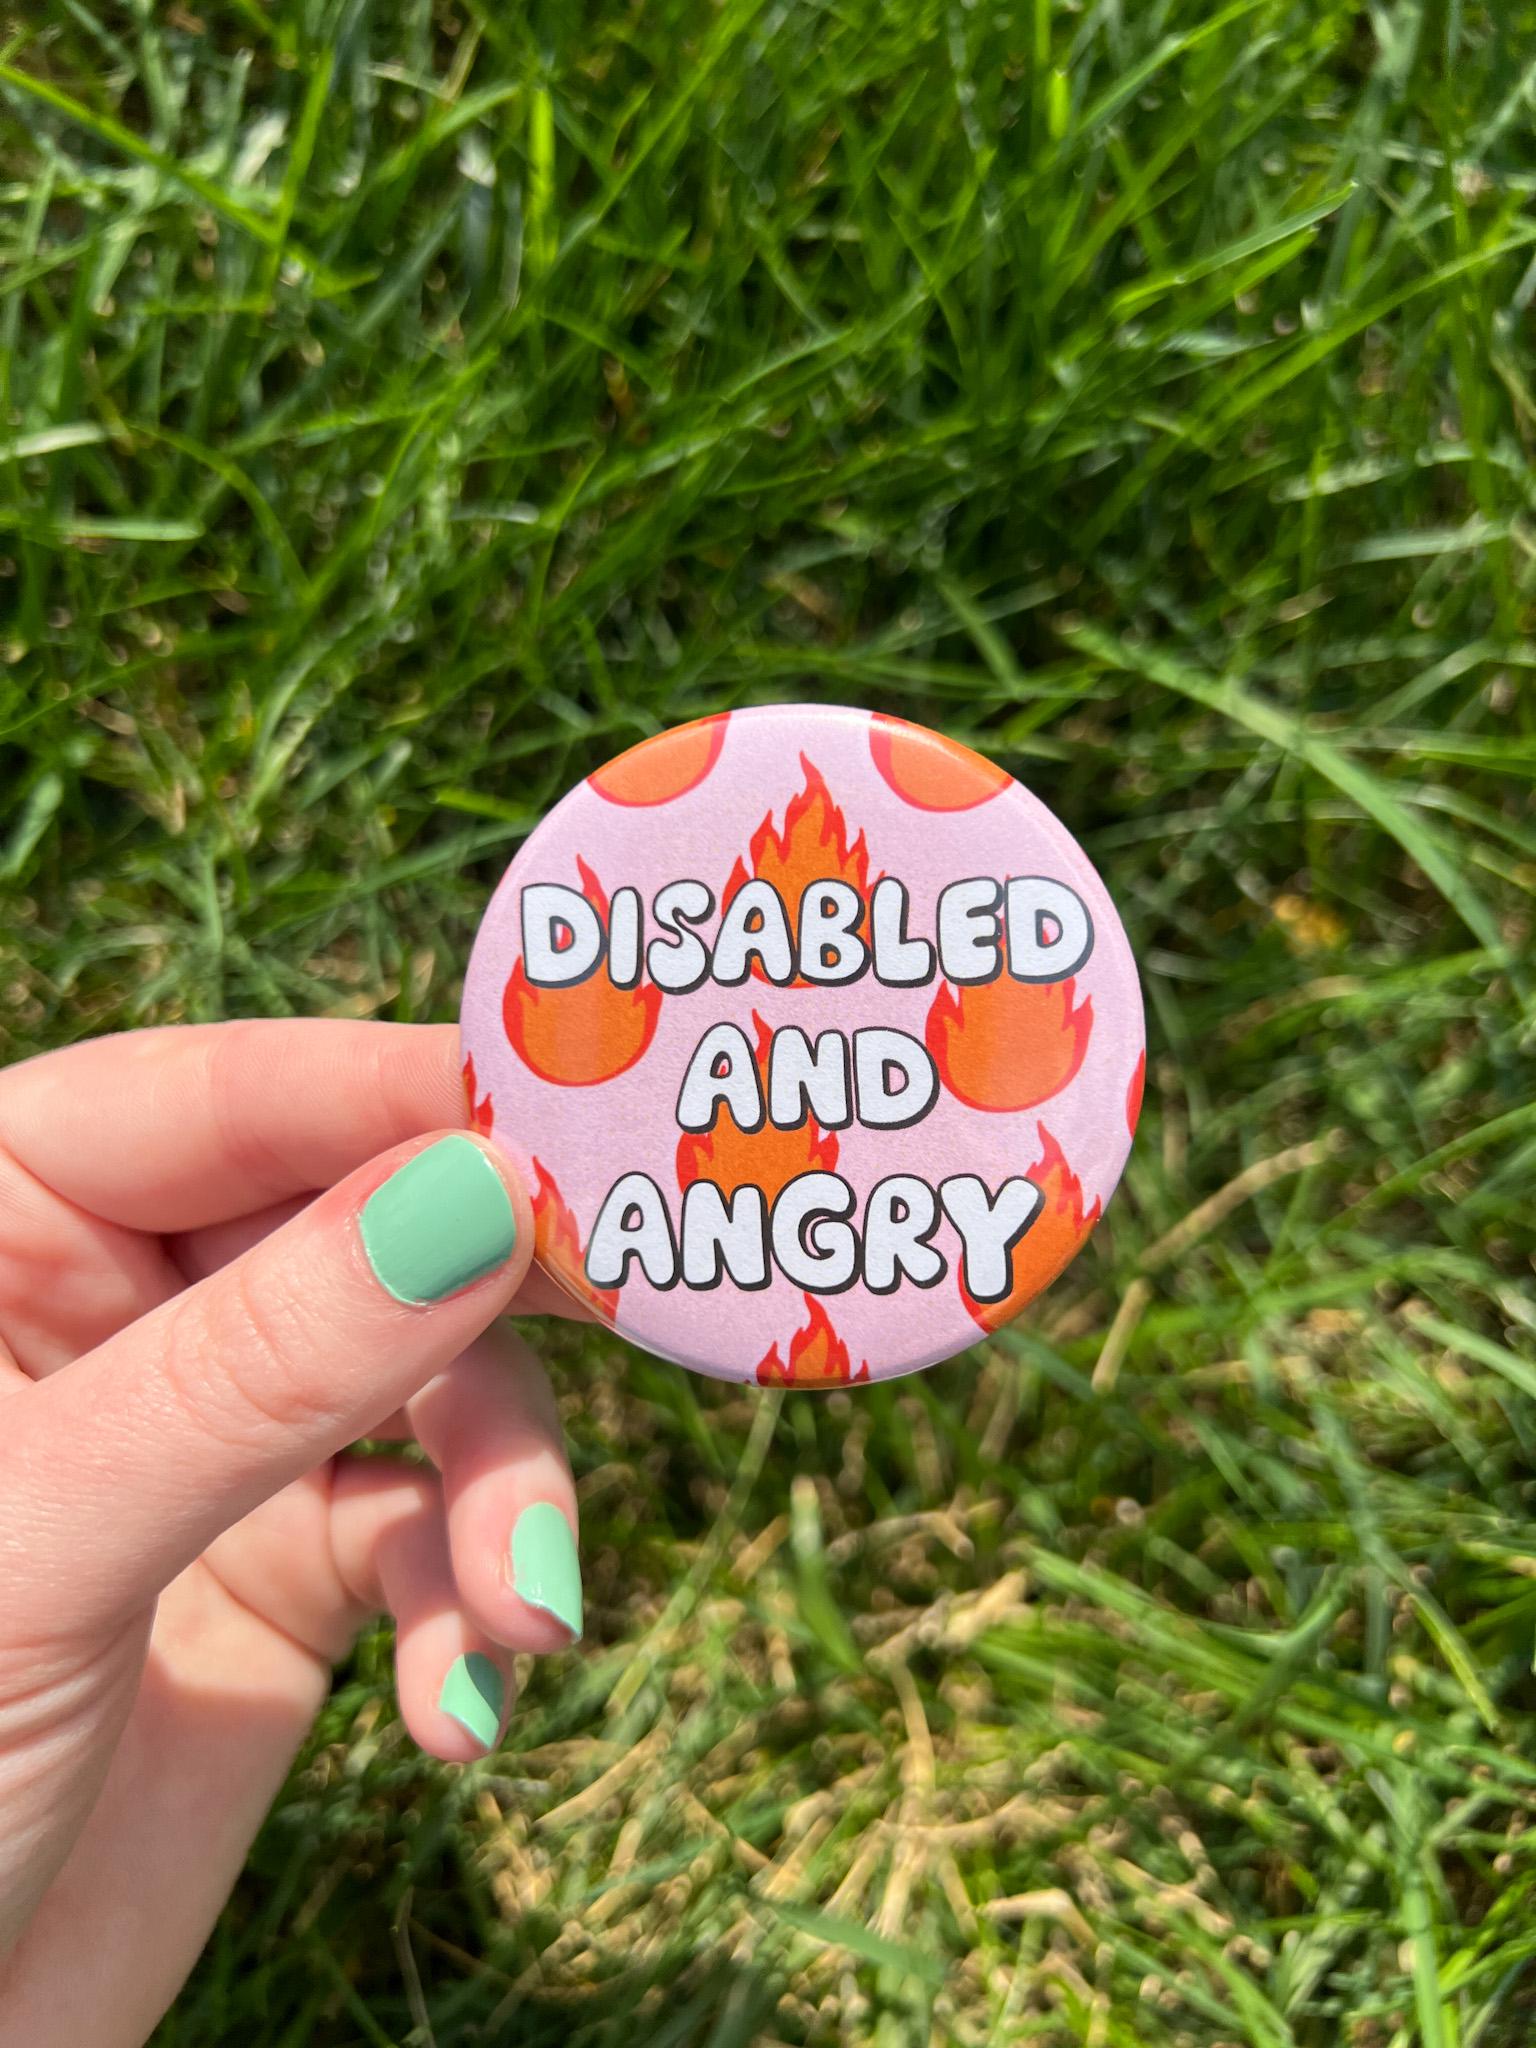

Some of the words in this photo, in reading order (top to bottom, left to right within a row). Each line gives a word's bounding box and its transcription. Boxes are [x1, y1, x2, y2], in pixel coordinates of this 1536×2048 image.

[520, 877, 1095, 994] DISABLED
[676, 1022, 940, 1133] AND
[585, 1171, 1045, 1302] ANGRY
